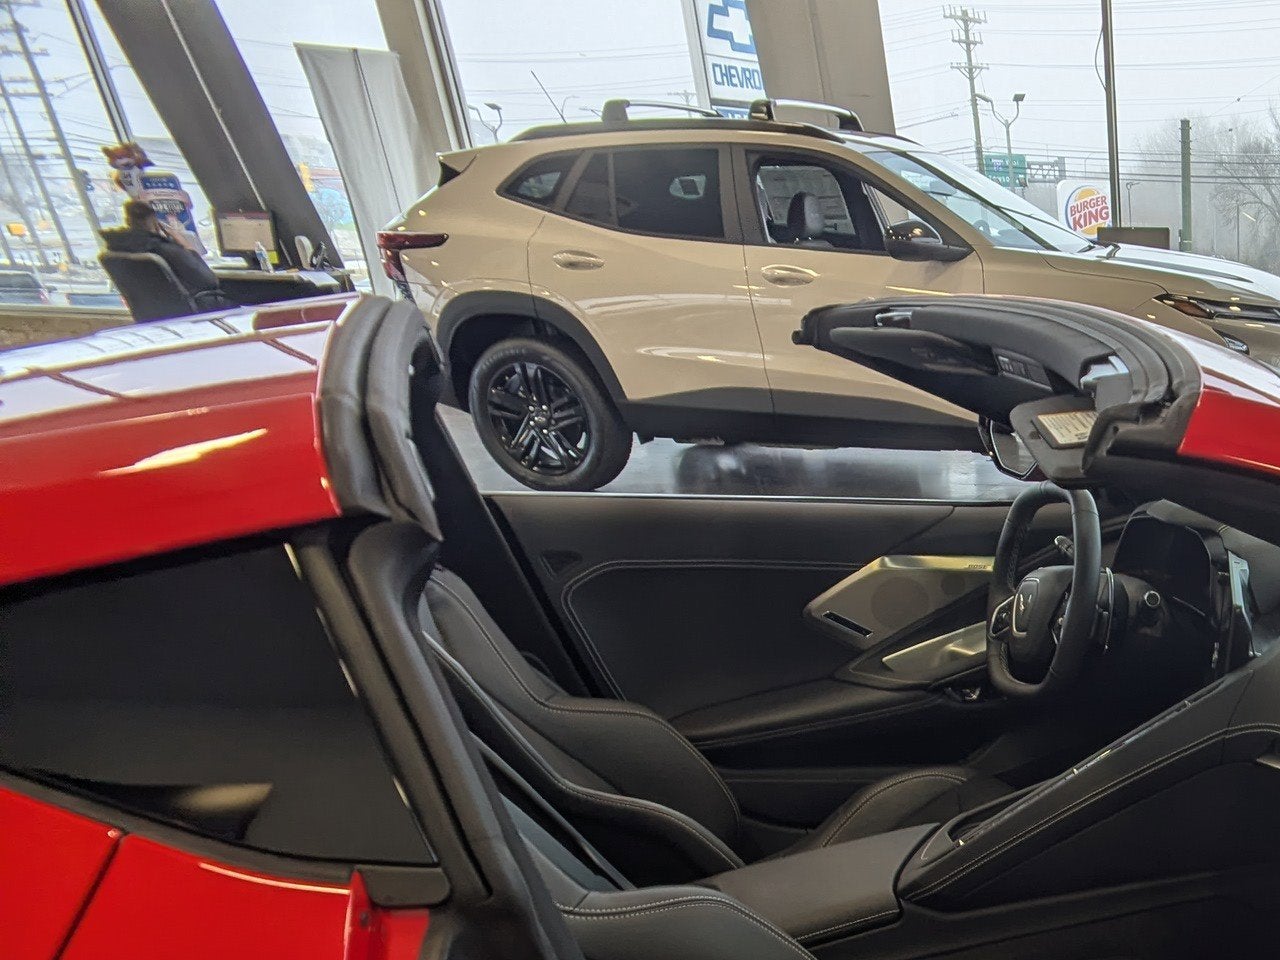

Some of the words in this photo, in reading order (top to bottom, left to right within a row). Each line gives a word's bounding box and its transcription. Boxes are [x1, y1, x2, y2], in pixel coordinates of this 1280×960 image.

[712, 63, 762, 90] CHEVRO
[1070, 195, 1107, 217] BURGER
[1072, 206, 1110, 231] KING
